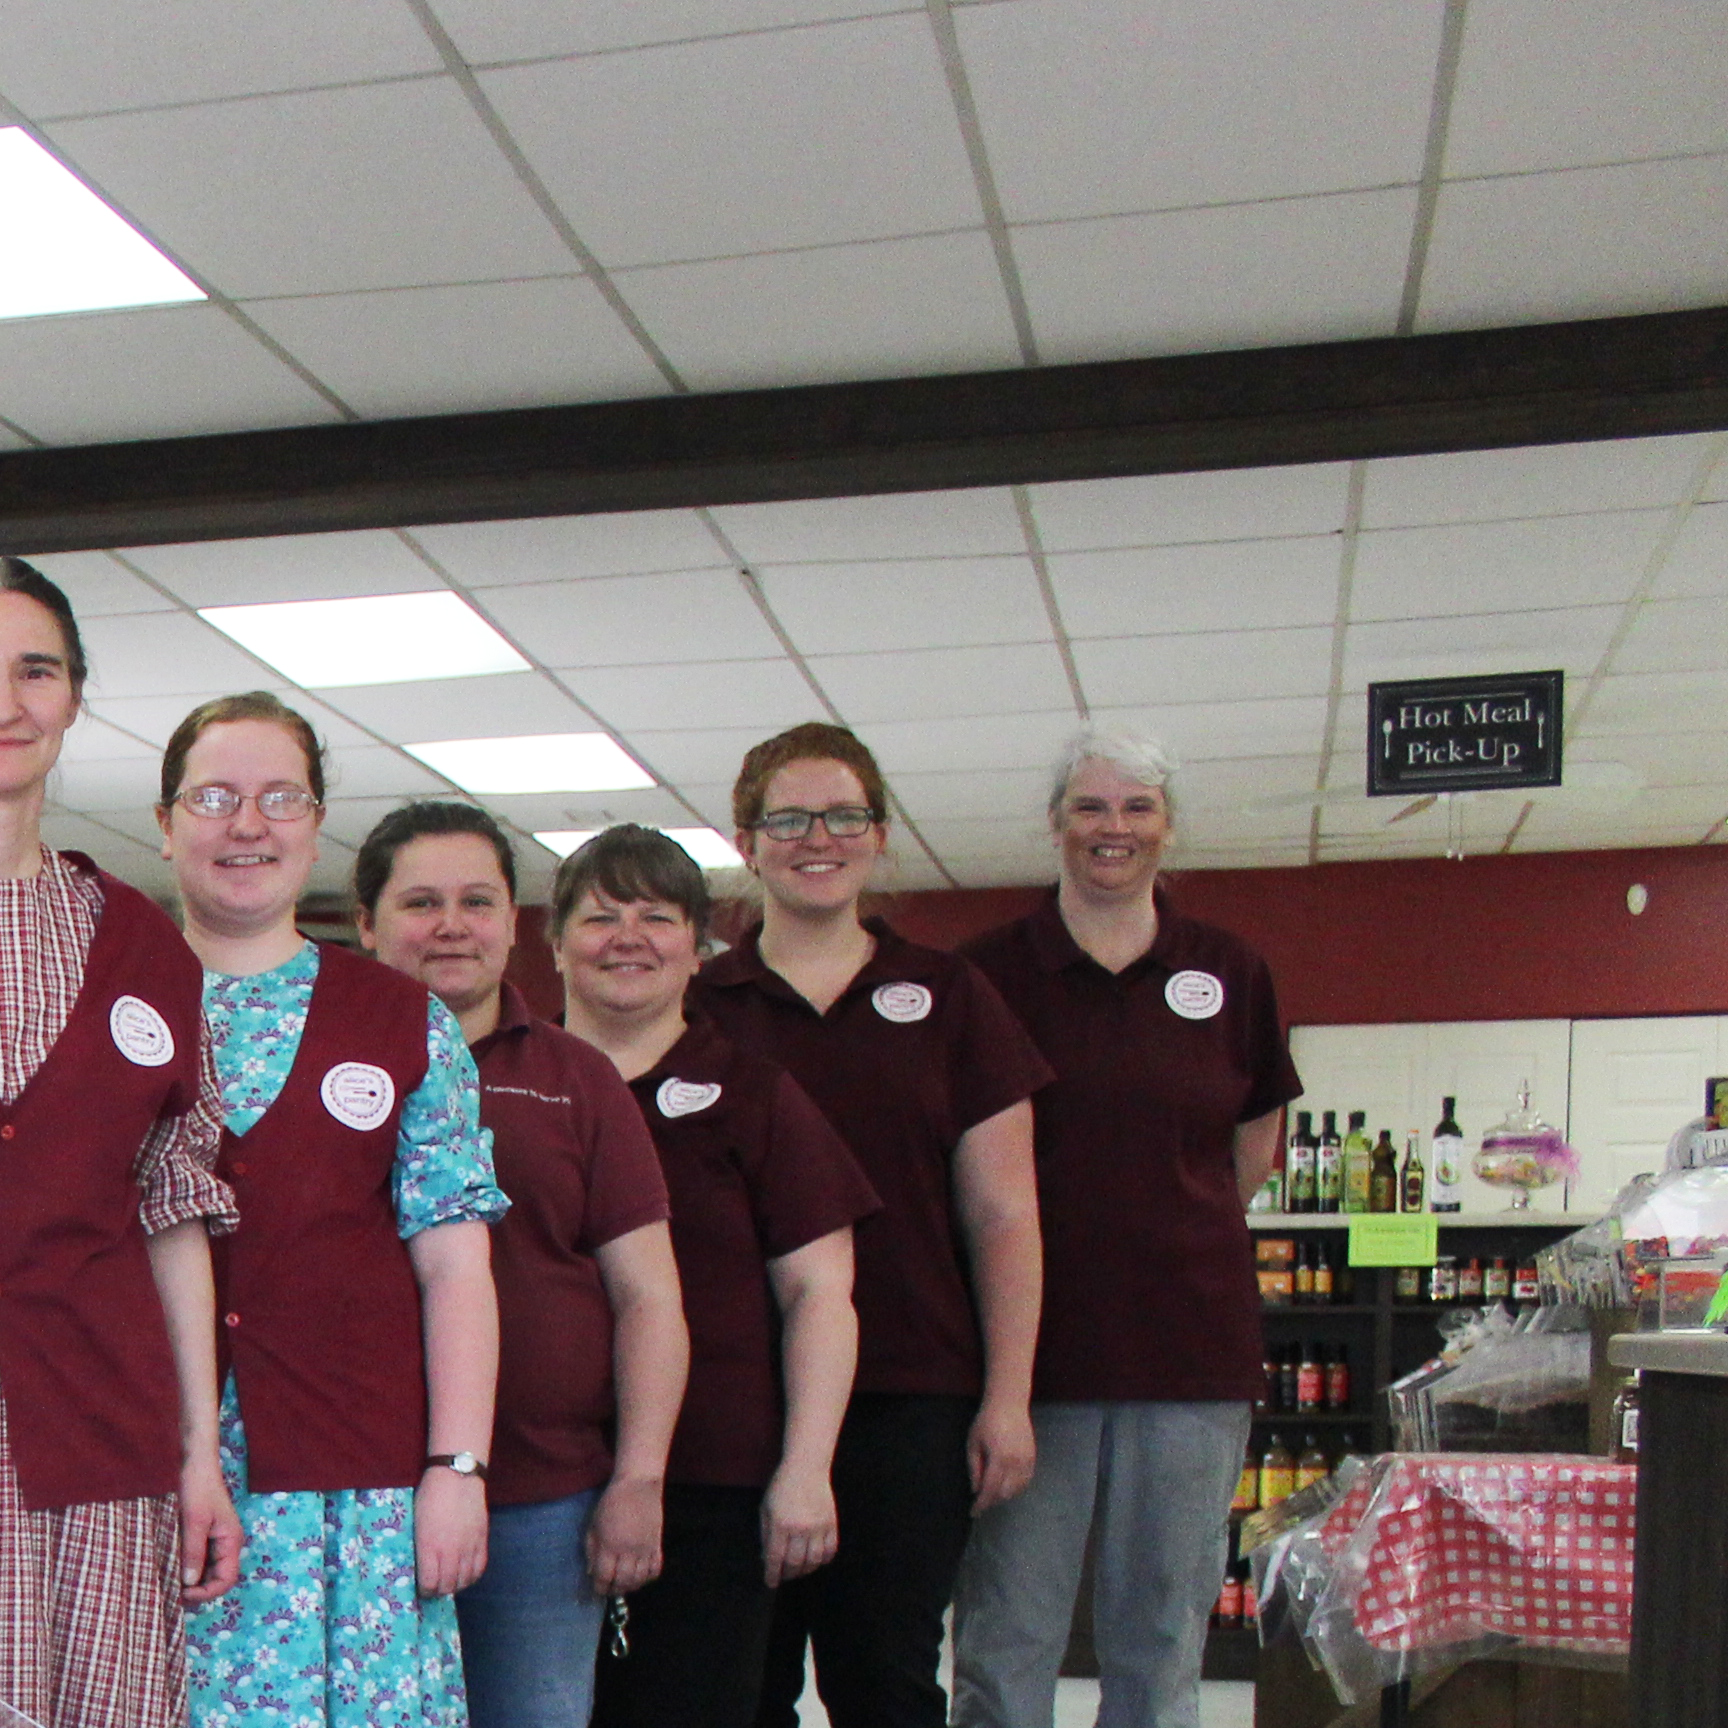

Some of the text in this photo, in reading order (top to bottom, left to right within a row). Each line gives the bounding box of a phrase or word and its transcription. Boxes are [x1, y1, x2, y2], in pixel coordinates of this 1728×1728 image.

[1399, 697, 1531, 730] Hot Meal
[1406, 737, 1521, 766] Pick-Up
